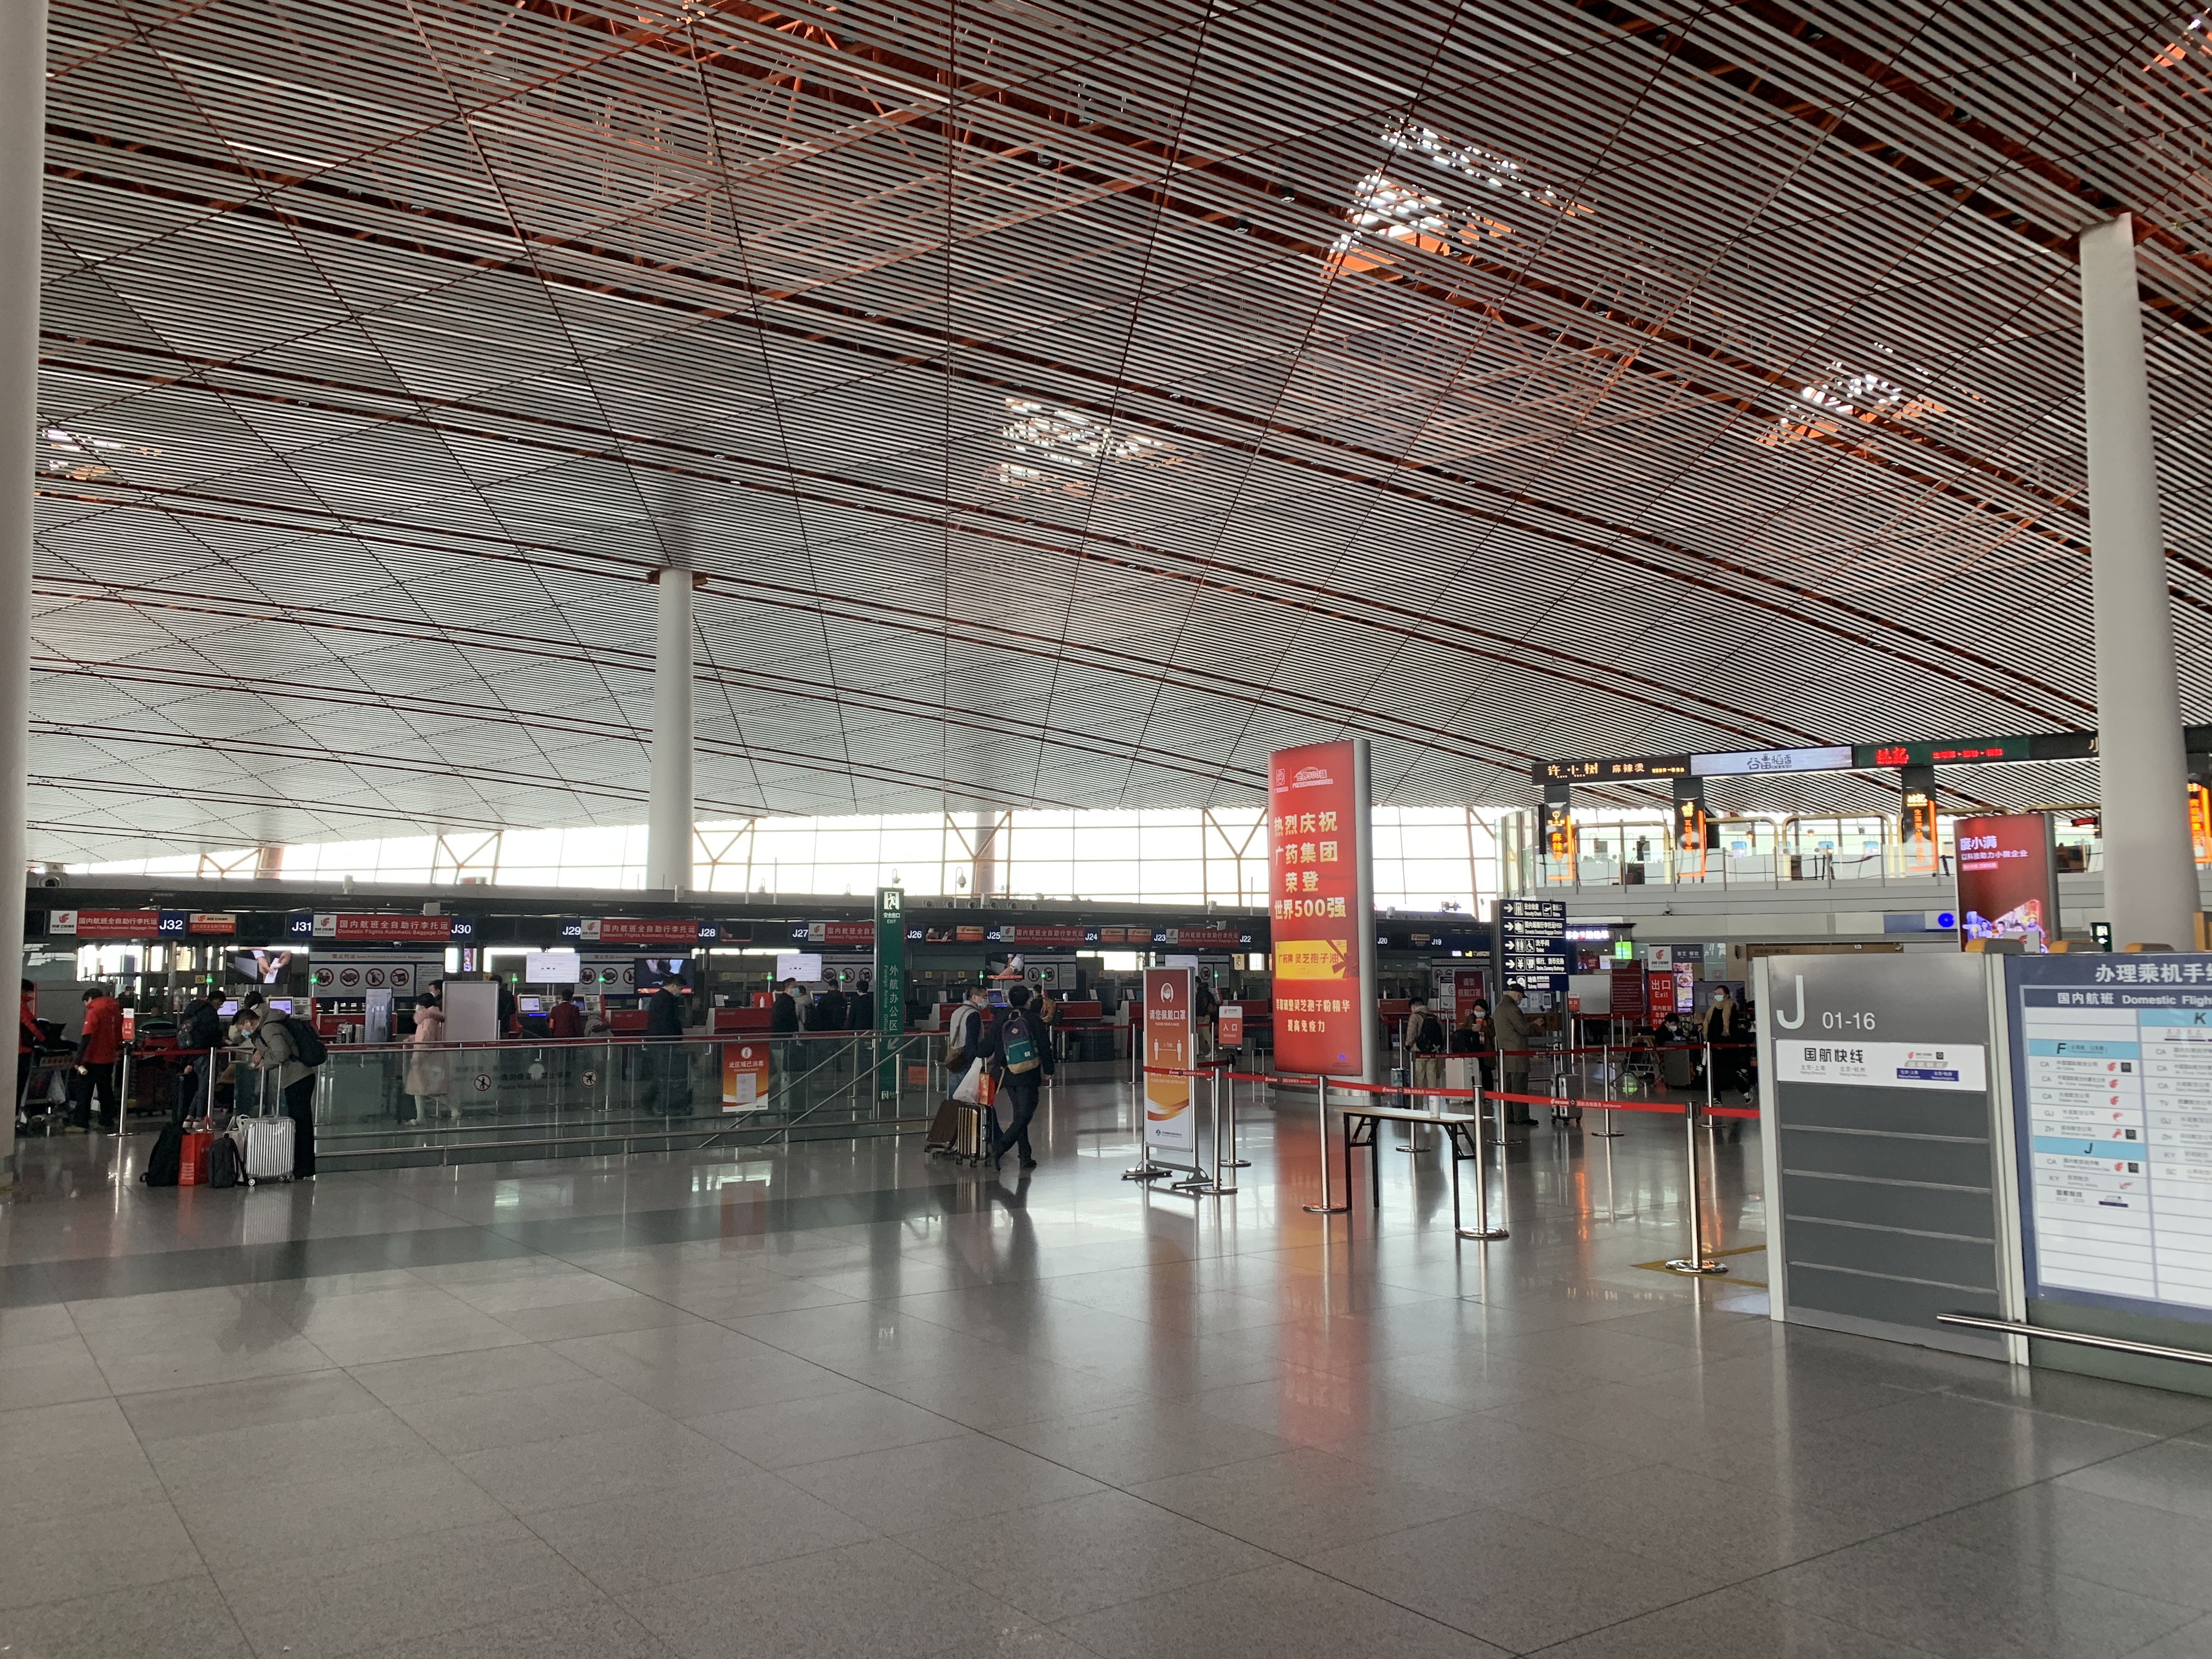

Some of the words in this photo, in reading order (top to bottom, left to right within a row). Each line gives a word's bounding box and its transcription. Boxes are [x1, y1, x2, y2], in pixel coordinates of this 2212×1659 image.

[1612, 763, 1645, 773] 麻辣烫
[1274, 811, 1338, 837] 热烈庆祝
[1552, 832, 1562, 861] 麻辣烫
[1960, 836, 1997, 851] 度小满
[1275, 841, 1338, 866] 广药集团
[1961, 850, 2028, 860] 以科技助力小微企业
[1285, 871, 1319, 893] 荣登
[1274, 897, 1346, 920] 世界500强
[78, 917, 158, 926] 国内航班全自助行李托运
[159, 919, 183, 930] J32
[292, 921, 311, 932] J31
[340, 920, 449, 930] 国内航班全自助行李托运
[452, 924, 471, 934] J30
[562, 927, 581, 935] J29
[603, 924, 695, 933] 国内航班全自助行李托运
[698, 928, 715, 937] J28
[792, 929, 808, 938] J27
[907, 930, 922, 939] J26
[987, 932, 1001, 940] J25
[1295, 953, 1339, 964] 灵芝孢子油
[2095, 963, 2212, 983] 办理乘机手
[1651, 979, 1671, 990] 出口
[889, 964, 899, 1031] 外航办公区
[1776, 975, 1805, 1030] J
[1822, 1012, 1876, 1030] 01-16
[2057, 992, 2114, 1005] 国内航班
[2122, 995, 2176, 1005] Domestic
[2182, 995, 2212, 1007] Fligh
[1149, 1009, 1186, 1020] 请您佩戴口罩
[2194, 1012, 2207, 1024] K
[1223, 1023, 1238, 1031] 入口
[1287, 1019, 1325, 1032] 提高免疫力
[2057, 1043, 2067, 1054] F
[1804, 1047, 1863, 1063] 国航快线
[2084, 1143, 2093, 1154] J
